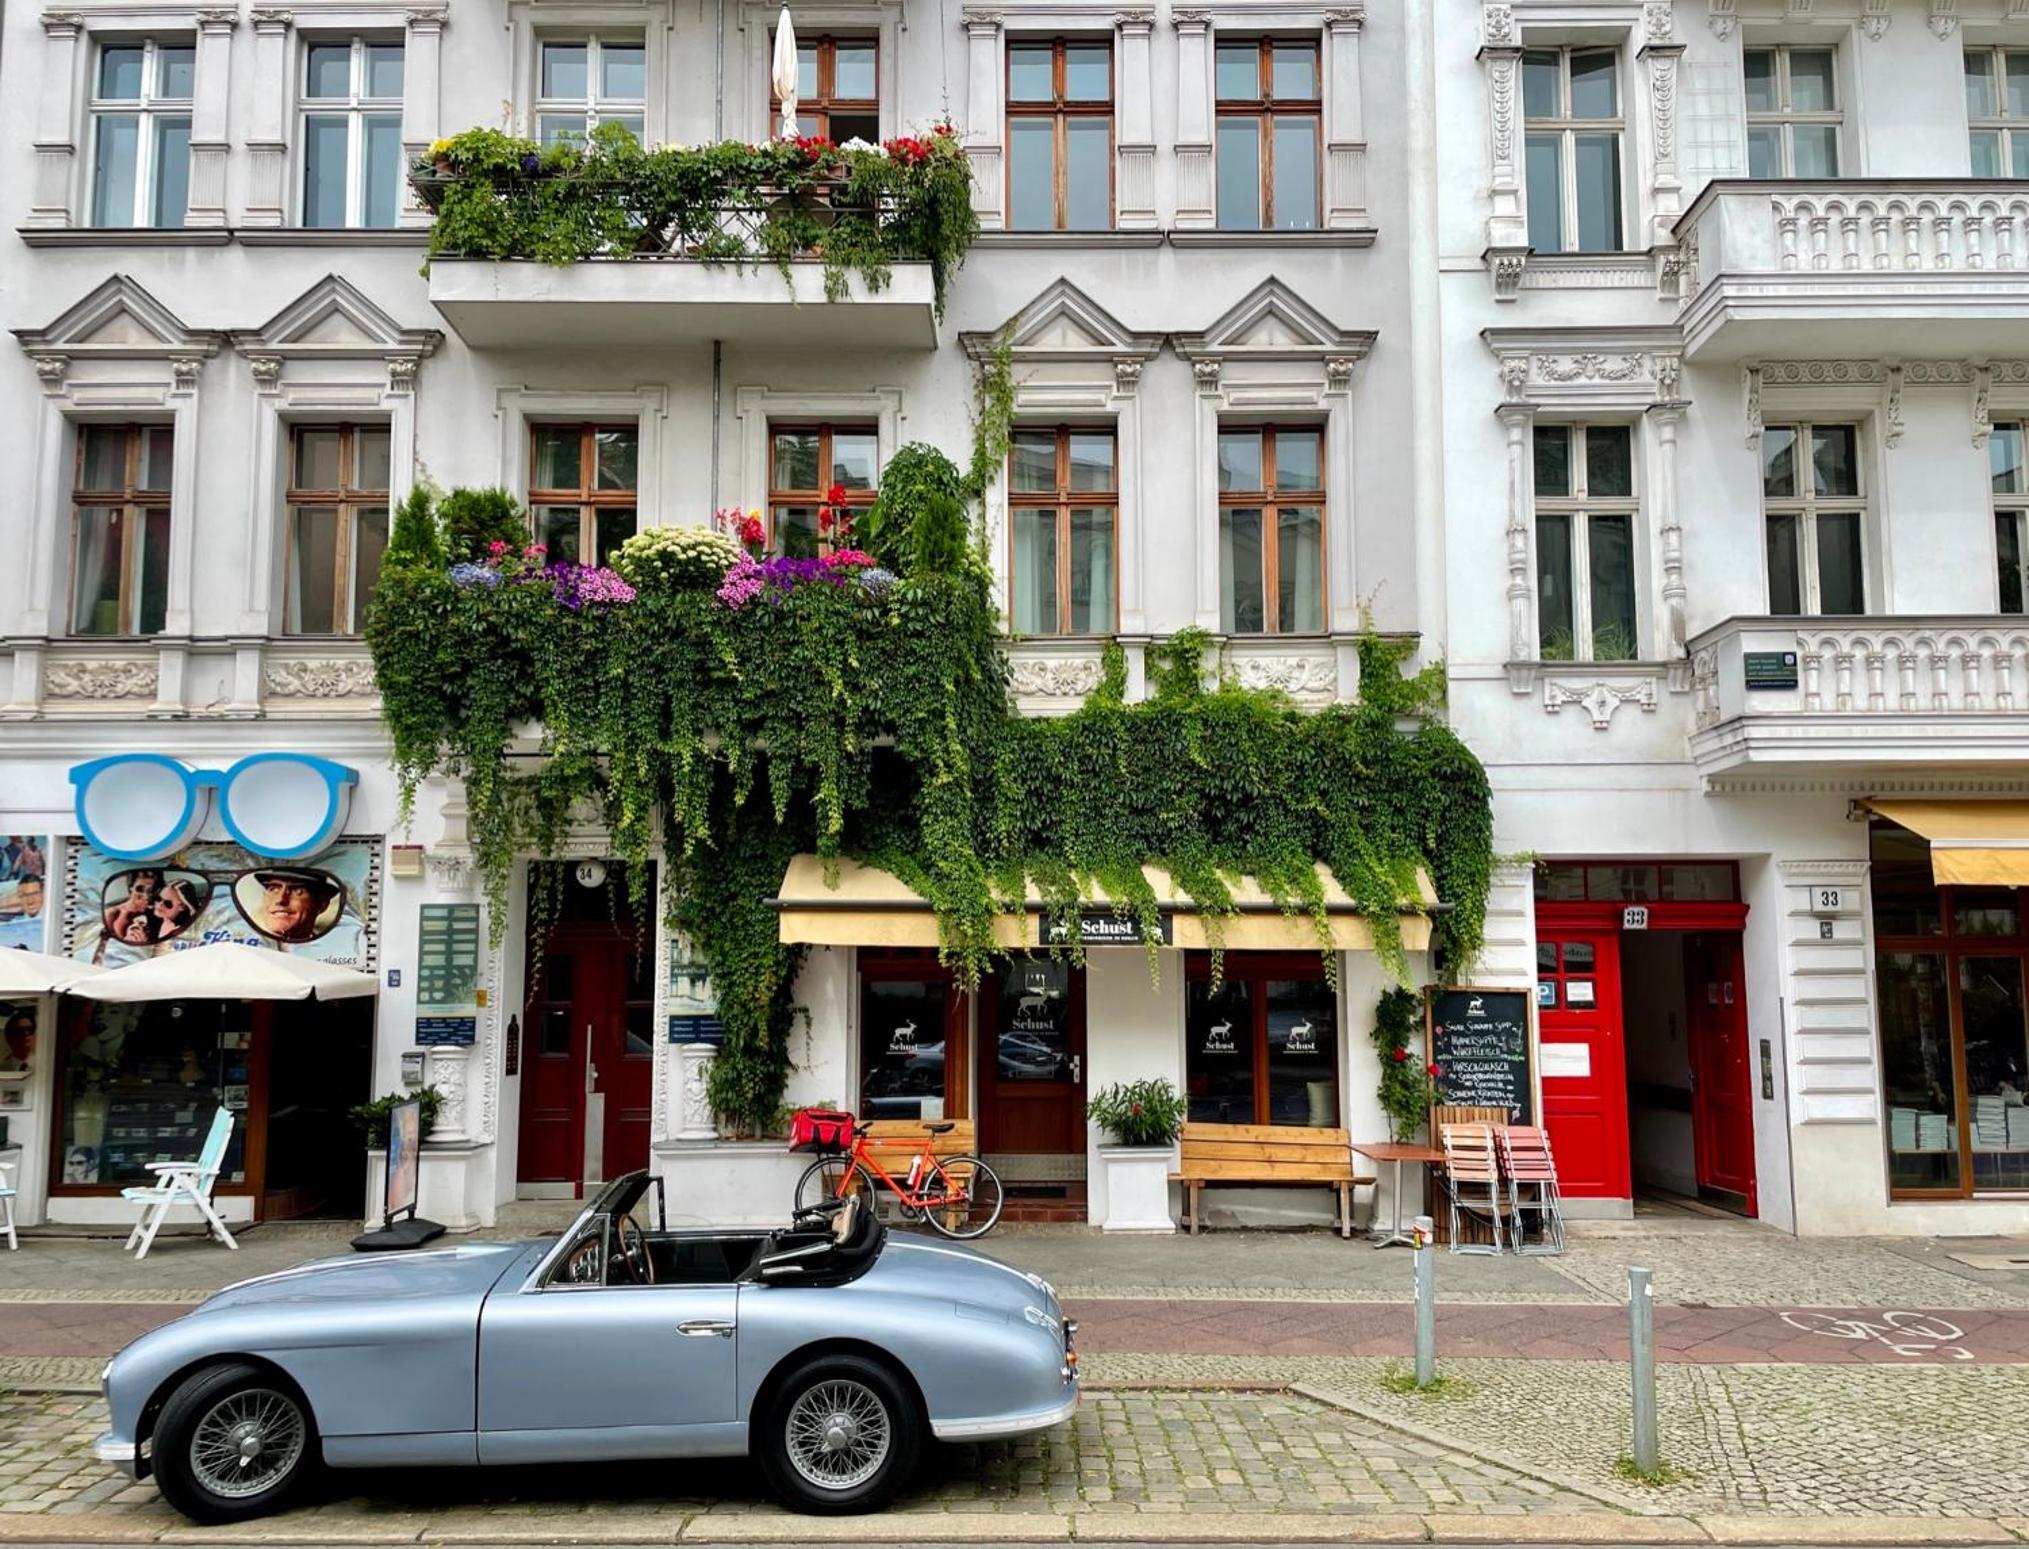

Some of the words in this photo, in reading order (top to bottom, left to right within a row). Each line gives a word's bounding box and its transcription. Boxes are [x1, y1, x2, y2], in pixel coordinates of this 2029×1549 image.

[580, 867, 592, 880] 34
[1821, 891, 1839, 906] 33
[1626, 910, 1646, 926] 33
[1081, 920, 1133, 934] Schust
[1537, 985, 1549, 1001] P
[1012, 1018, 1054, 1030] Schust
[890, 1042, 918, 1051] Schust
[1206, 1041, 1234, 1050] Schust
[1286, 1041, 1315, 1050] Schust
